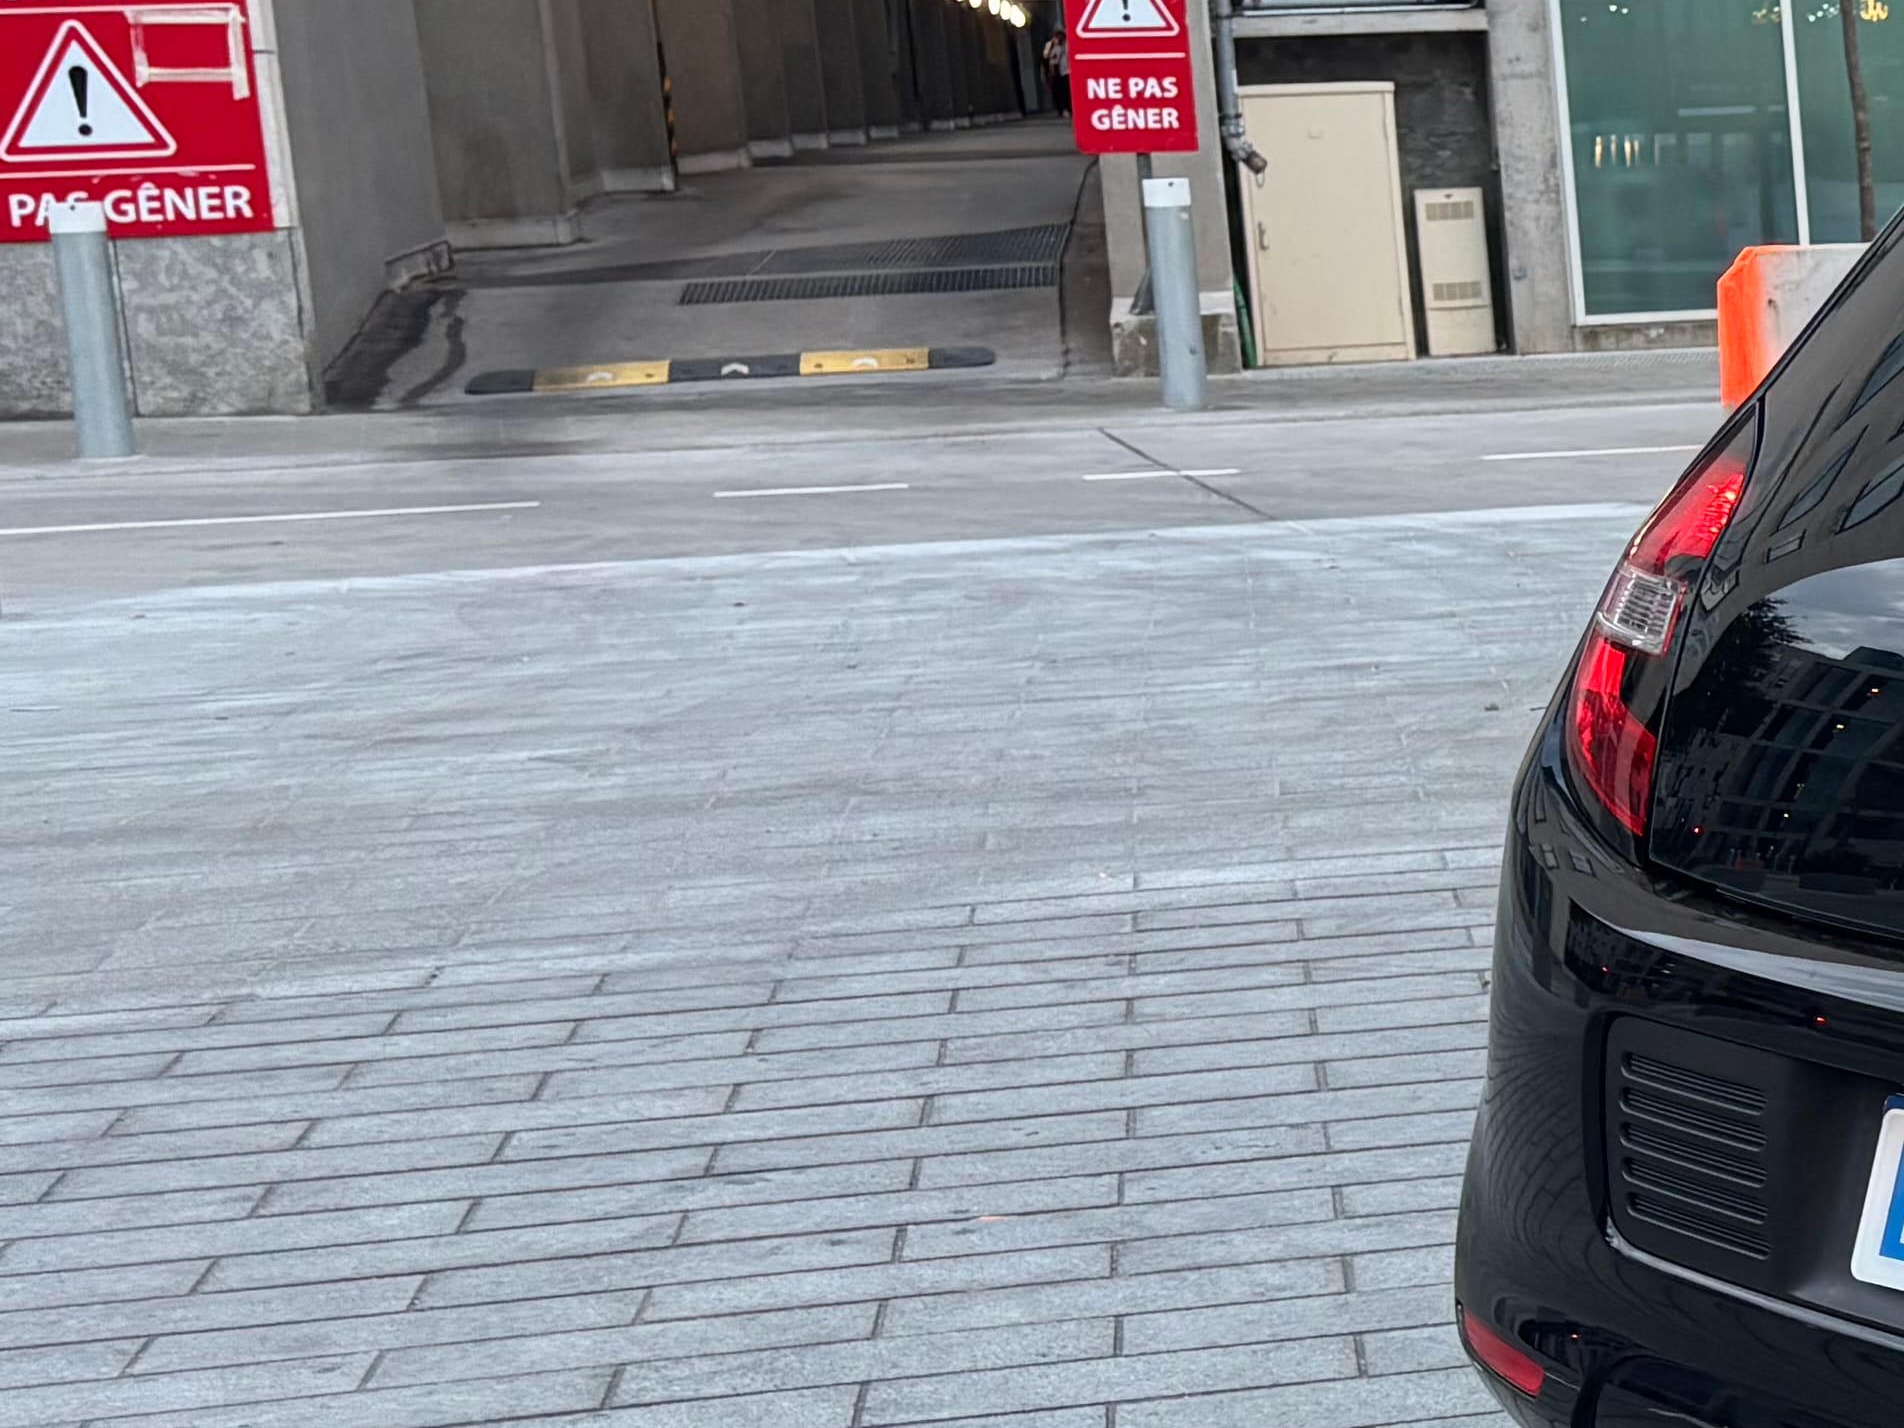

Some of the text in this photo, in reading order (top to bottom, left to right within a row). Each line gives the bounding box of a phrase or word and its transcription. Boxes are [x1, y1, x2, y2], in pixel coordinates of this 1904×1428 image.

[1087, 76, 1178, 100] NE PAS
[1091, 104, 1180, 131] GÊNER
[8, 182, 254, 227] PA GÊNER
